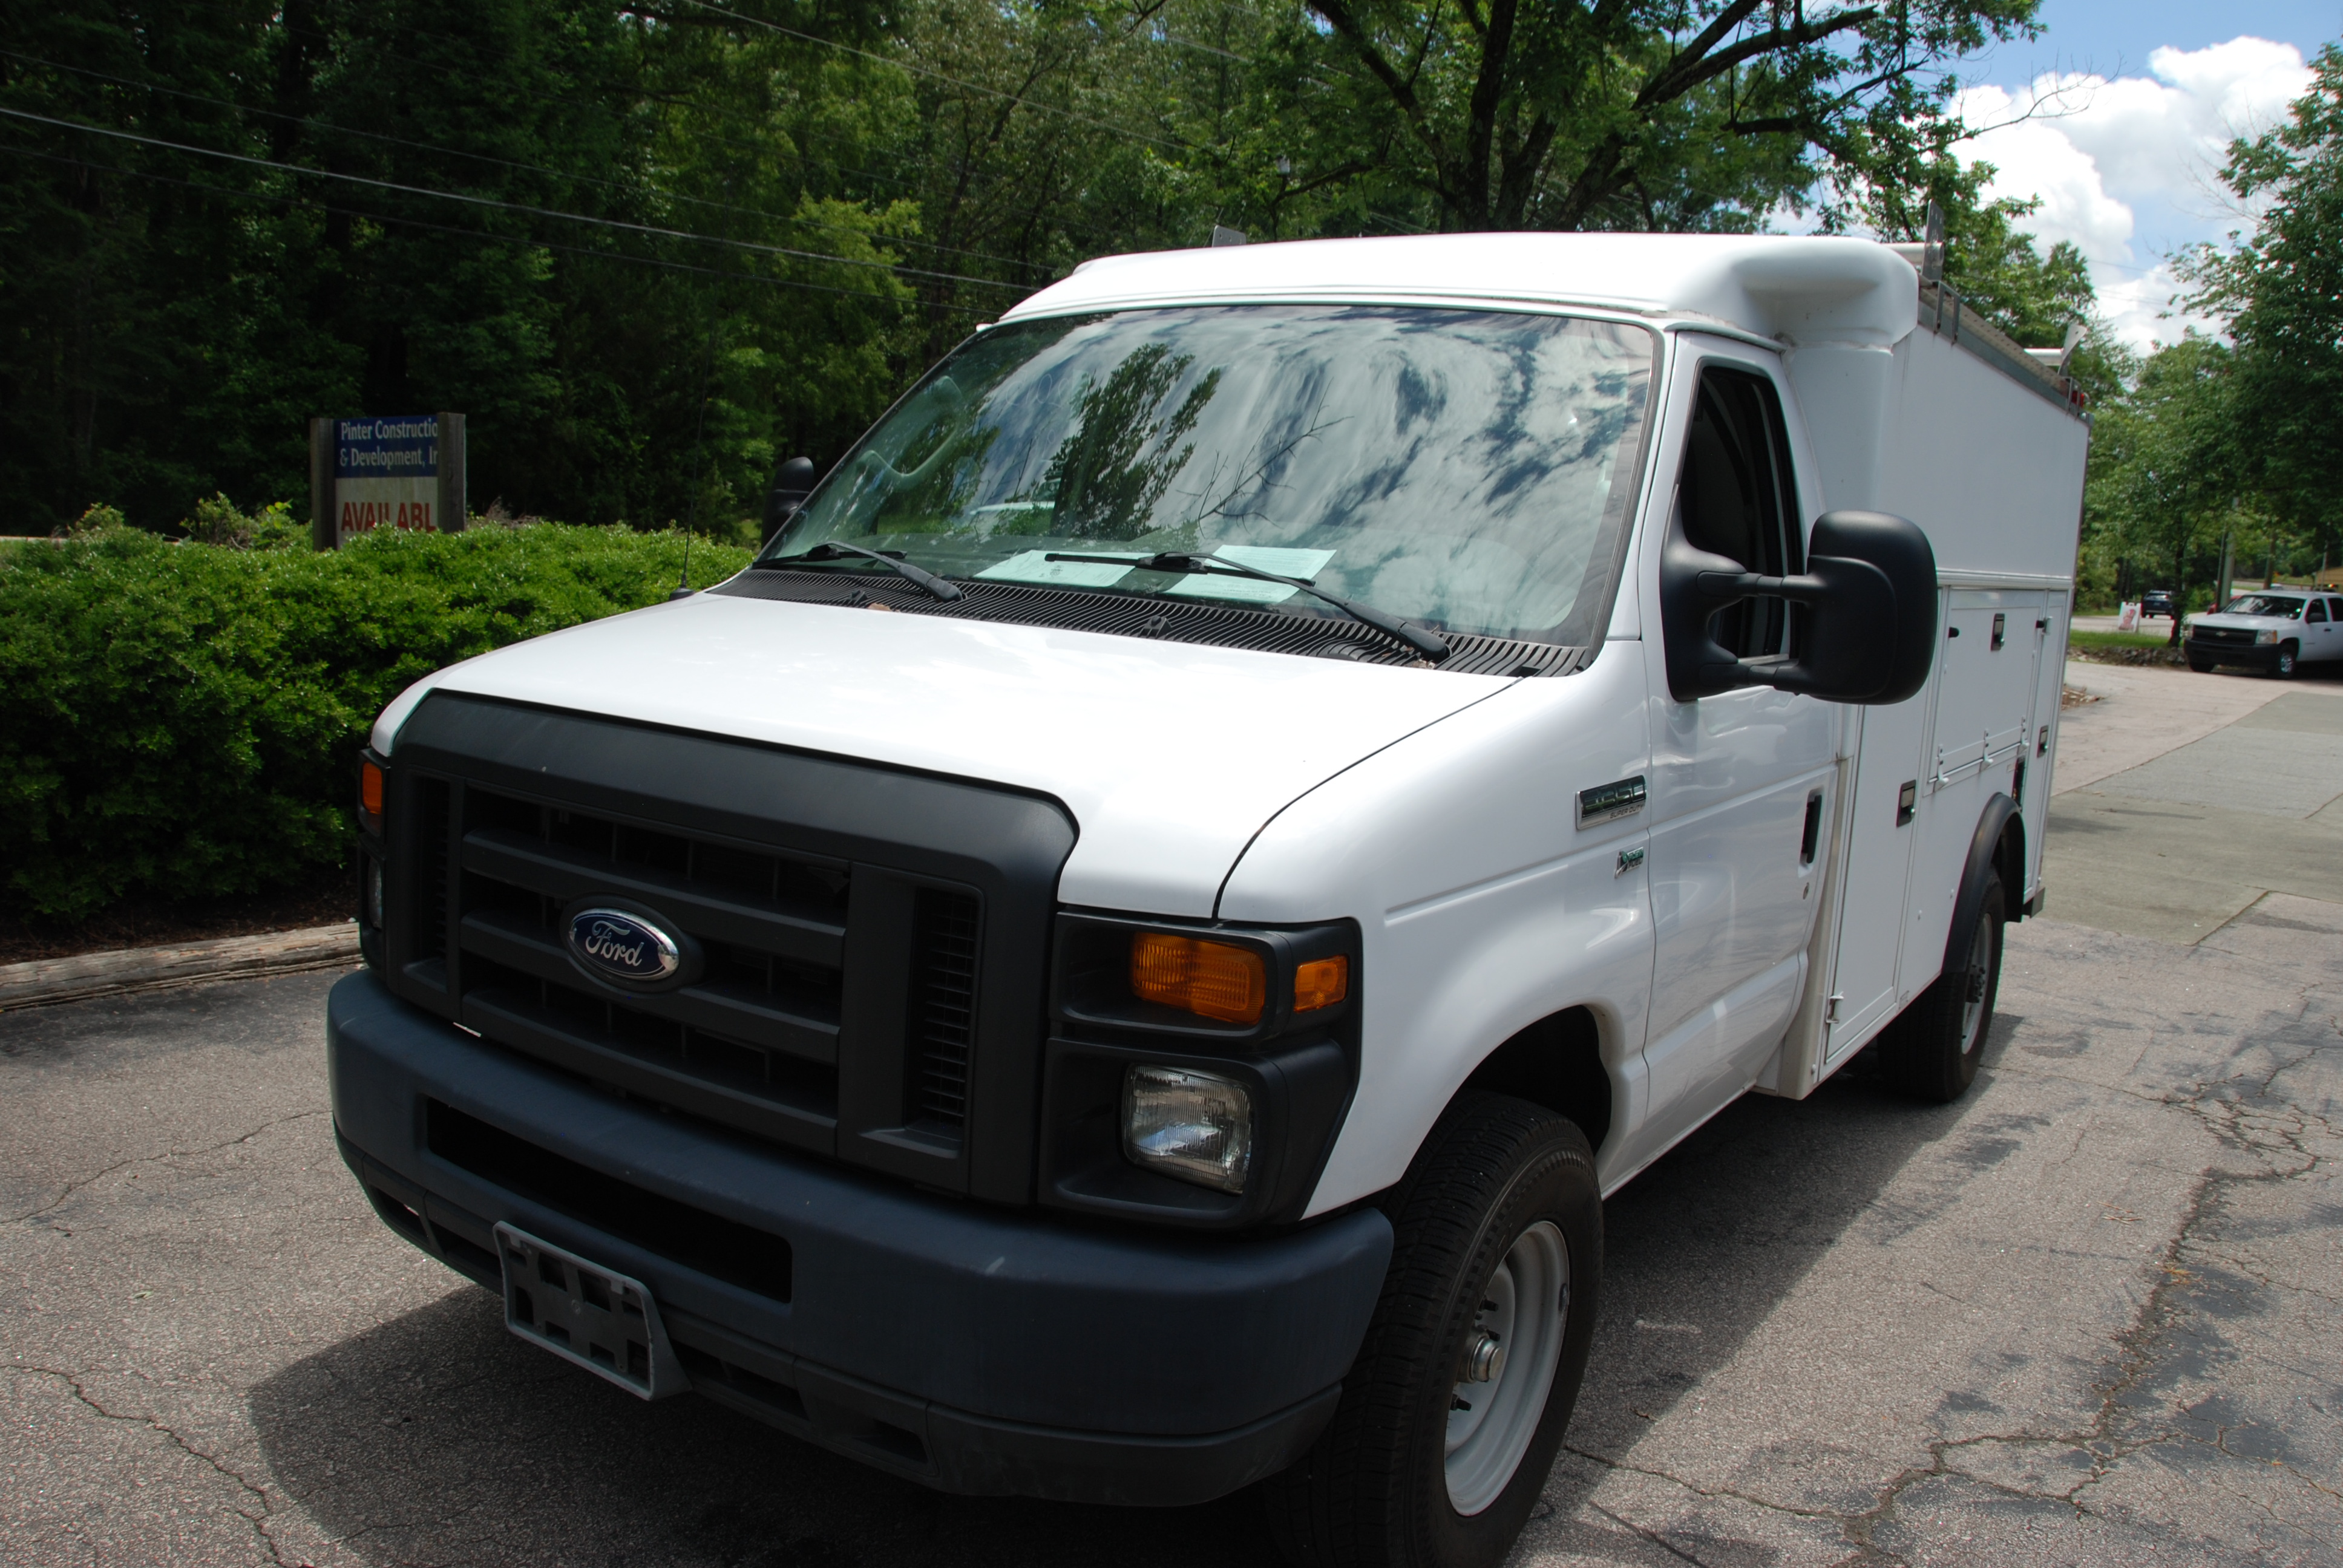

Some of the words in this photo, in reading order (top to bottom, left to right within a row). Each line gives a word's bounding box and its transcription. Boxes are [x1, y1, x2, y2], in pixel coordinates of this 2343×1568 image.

[341, 422, 373, 440] Pinter
[339, 448, 349, 467] &
[351, 445, 426, 470] Development,
[1610, 809, 1628, 818] SUPER
[1628, 803, 1643, 812] DUTY
[585, 920, 644, 967] Ford
